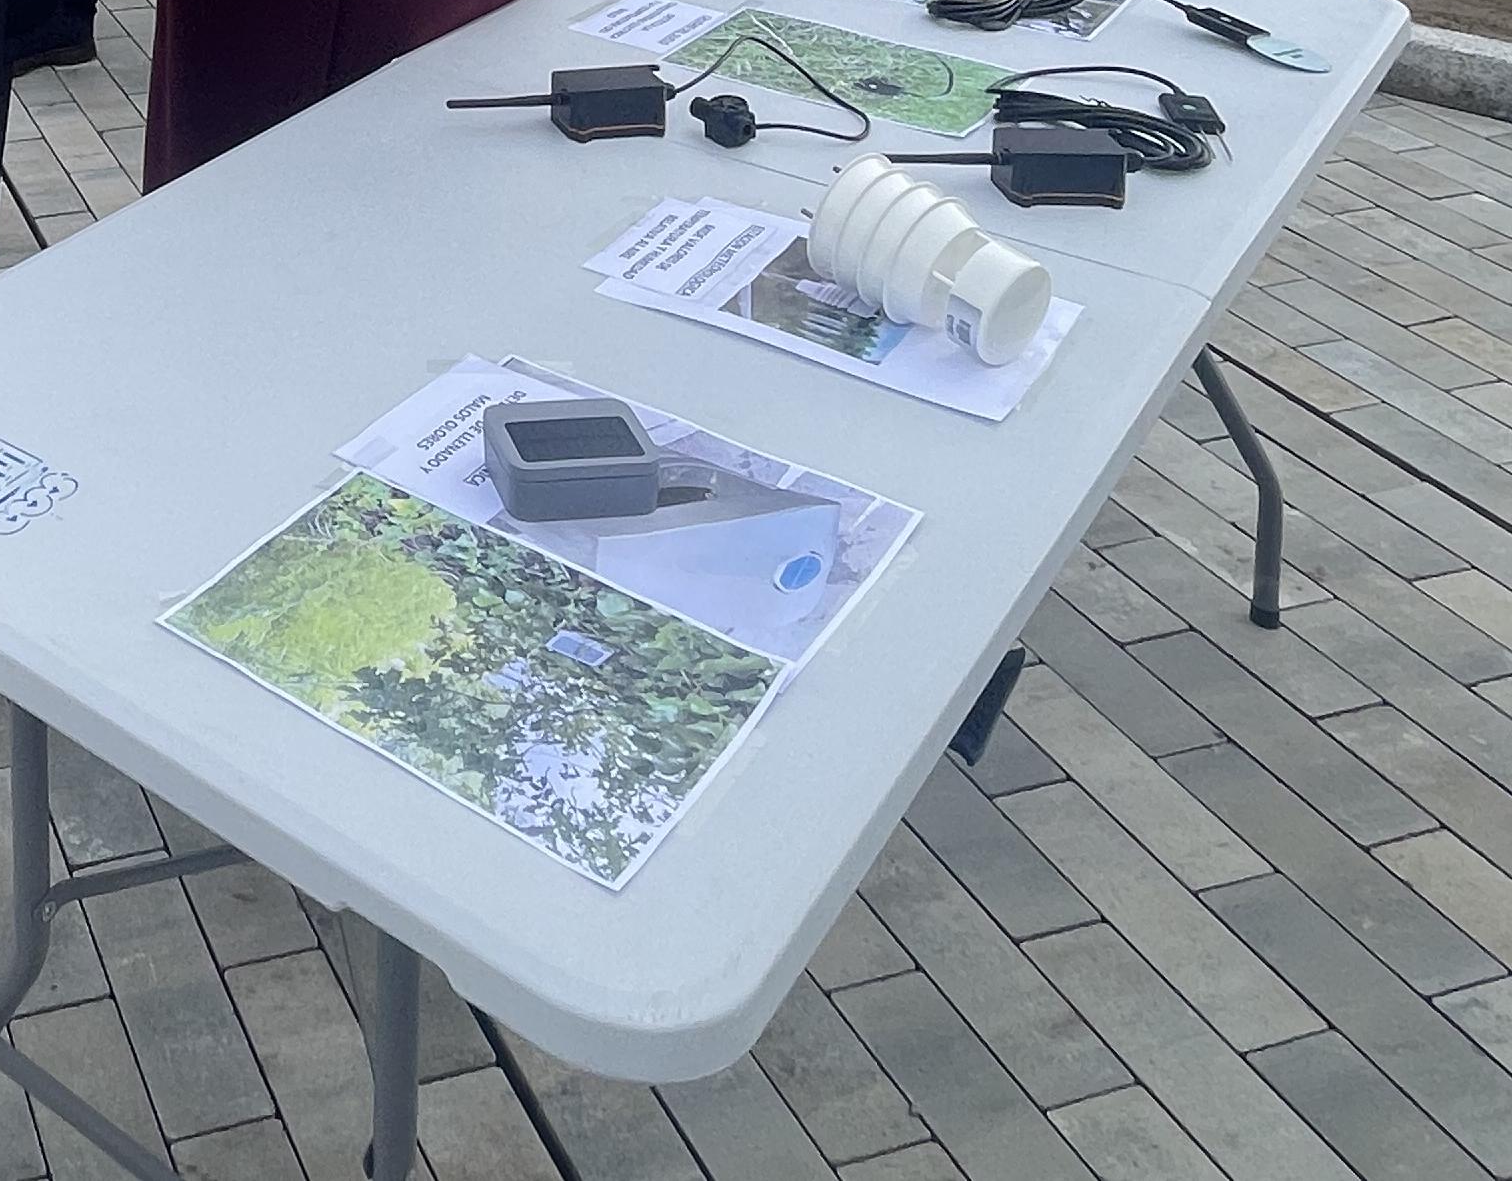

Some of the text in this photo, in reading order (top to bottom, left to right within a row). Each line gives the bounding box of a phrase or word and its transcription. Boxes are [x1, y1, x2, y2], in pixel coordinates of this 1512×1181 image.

[453, 395, 491, 421] MALOS
[417, 420, 458, 450] OLORES
[427, 431, 474, 467] LLENADO
[420, 466, 432, 474] Y
